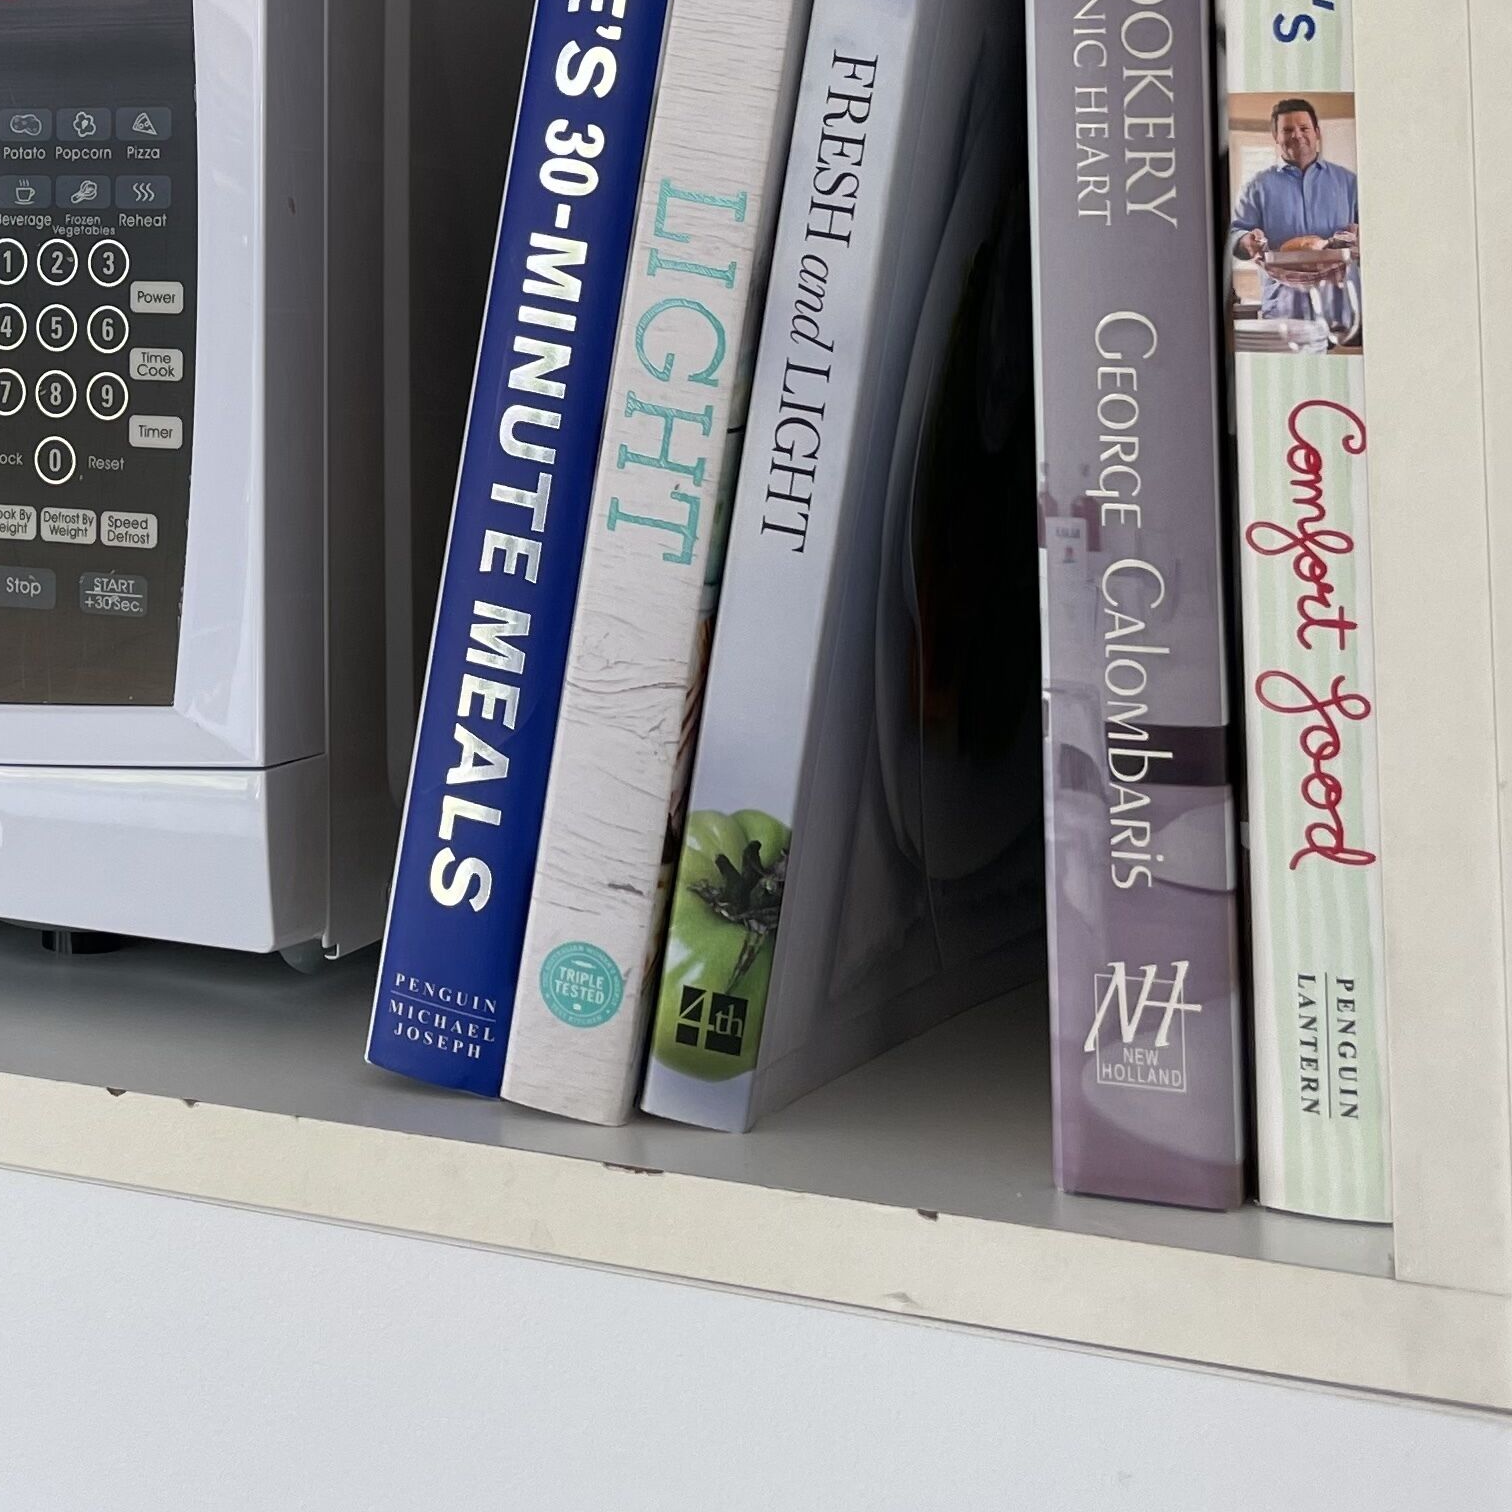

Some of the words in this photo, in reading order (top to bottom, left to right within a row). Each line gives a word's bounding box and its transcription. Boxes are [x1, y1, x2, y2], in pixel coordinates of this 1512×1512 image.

[2, 146, 47, 160] Potato
[54, 146, 112, 162] Popcorn
[126, 145, 161, 160] Pizza
[805, 48, 880, 249] FRESH
[1073, 86, 1113, 227] HEART
[65, 213, 101, 225] Frozen
[118, 213, 168, 228] Reheat
[51, 225, 116, 238] Vegetables
[2, 250, 12, 273] 1
[51, 251, 64, 274] 2
[102, 251, 115, 275] 3
[137, 290, 176, 304] Power
[790, 252, 835, 353] and
[0, 315, 12, 338] 4
[50, 316, 63, 339] 5
[101, 317, 114, 341] 6
[141, 351, 172, 364] Time
[479, 118, 605, 584] 30-MINUTE
[136, 363, 175, 378] Cook
[607, 177, 748, 565] LIGHT
[0, 380, 11, 403] 7
[49, 382, 62, 406] 8
[101, 384, 113, 408] 9
[138, 424, 174, 439] Timer
[1084, 310, 1159, 530] GEORGE
[48, 448, 62, 472] 0
[88, 456, 125, 471] Reset
[759, 355, 832, 554] LIGHT
[19, 508, 33, 523] By
[43, 510, 81, 525] Defrost
[82, 514, 94, 527] By
[107, 514, 149, 532] Speed
[1245, 399, 1367, 651] Comfort
[49, 524, 88, 540] Weight
[107, 529, 150, 545] Defrost
[6, 576, 42, 598] Stop
[93, 577, 135, 594] START
[428, 600, 533, 914] MEALS
[558, 965, 605, 990] TRIPLE
[395, 972, 497, 1014] PENGUIN
[554, 979, 605, 1005] TESTED
[1083, 959, 1203, 1053] NH
[388, 999, 496, 1043] MICHAEL
[677, 985, 748, 1056] 4th
[393, 1022, 481, 1060] JOSEPH
[1296, 972, 1321, 1116] LANTERN
[1335, 977, 1359, 1120] PENGUIN
[1122, 1046, 1160, 1067] NEW
[1101, 1063, 1183, 1088] HOLLAND
